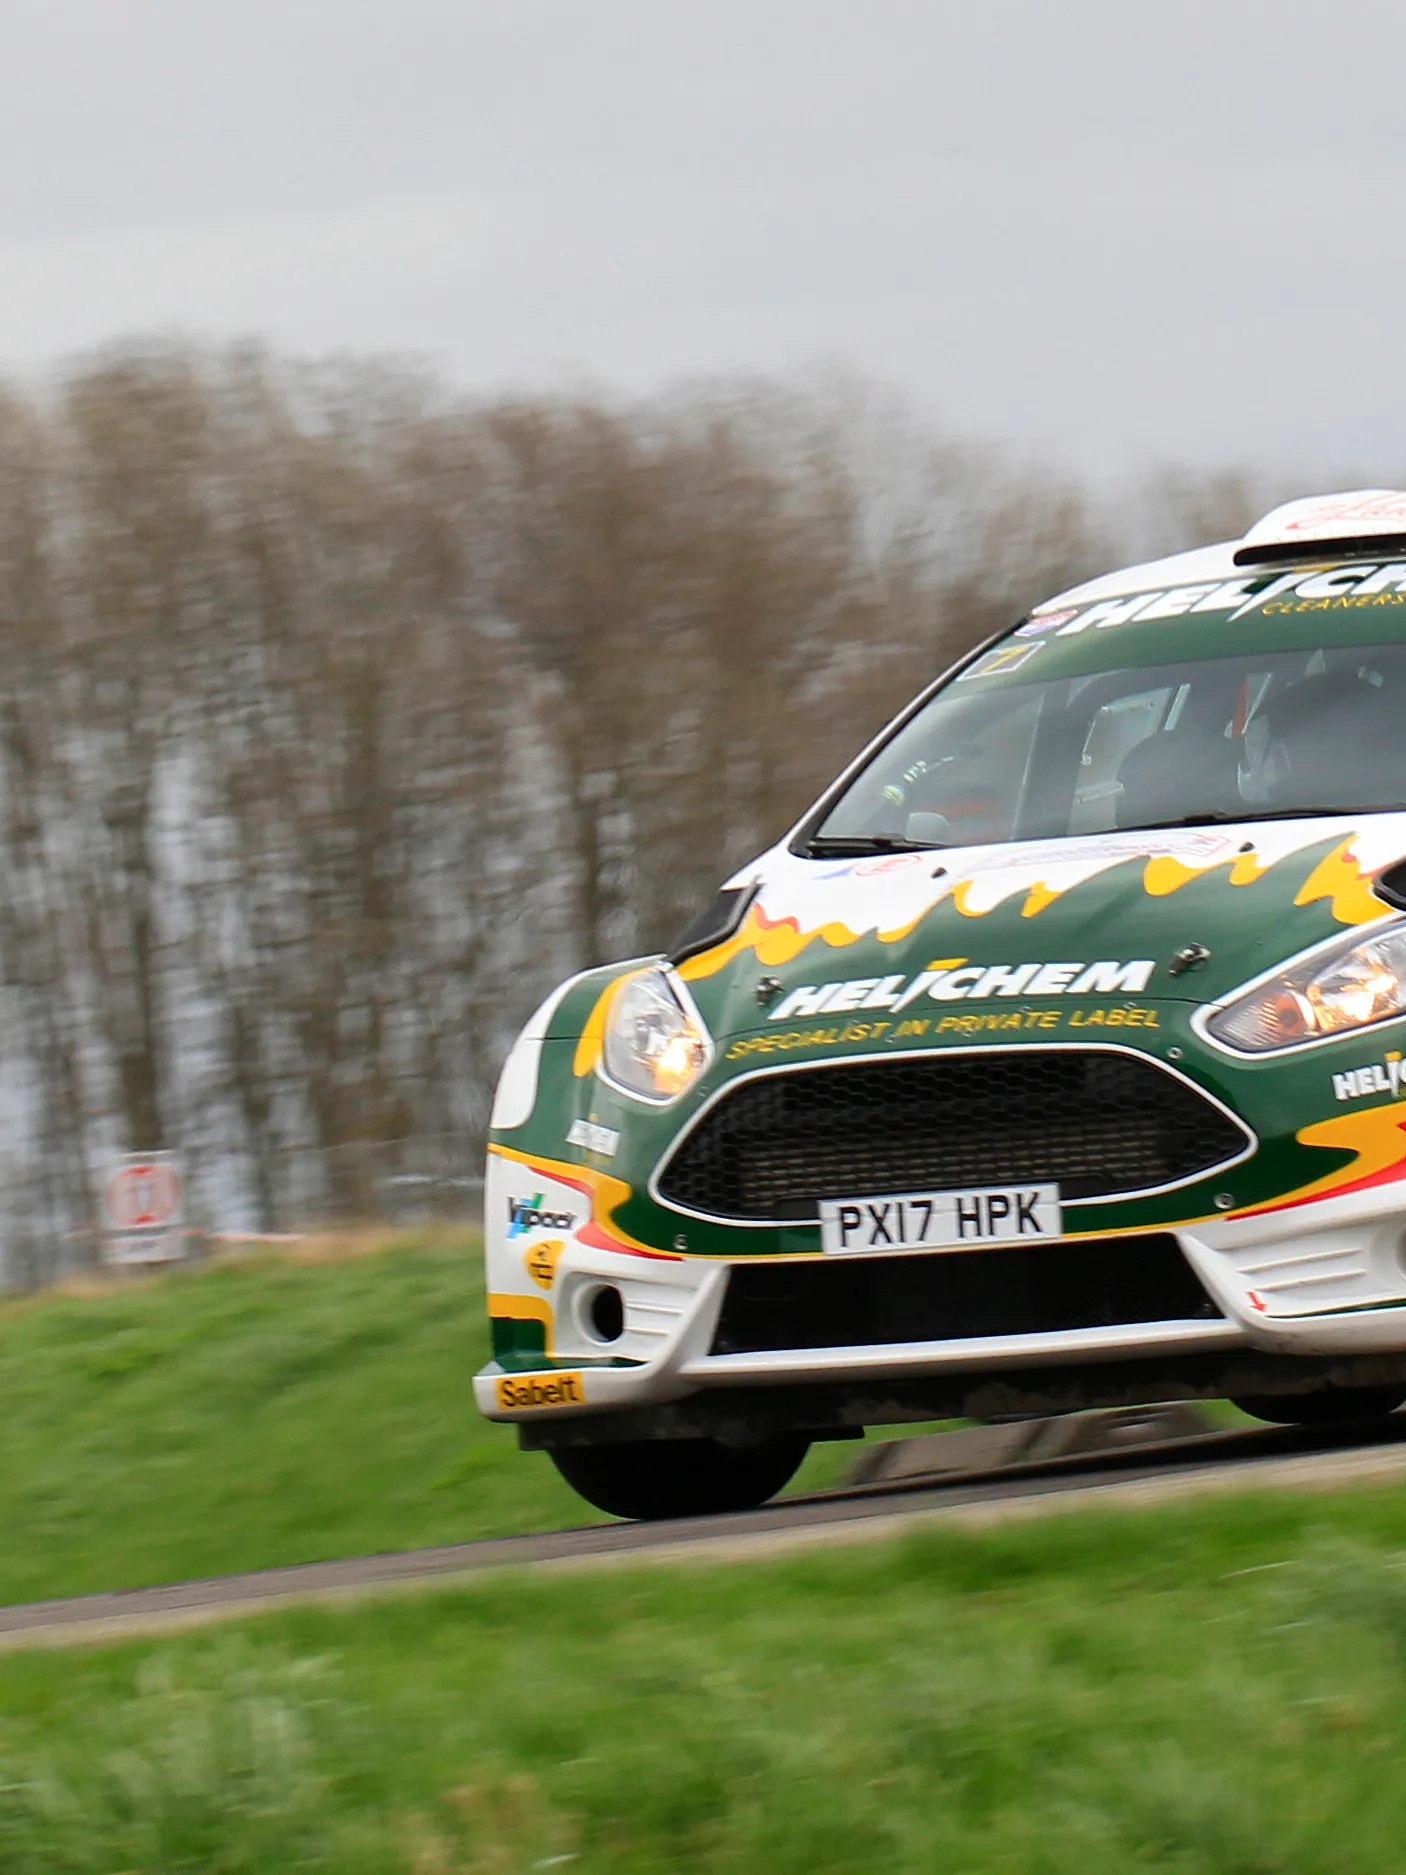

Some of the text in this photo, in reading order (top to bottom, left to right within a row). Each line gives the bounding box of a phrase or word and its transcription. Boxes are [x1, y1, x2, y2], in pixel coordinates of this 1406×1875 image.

[725, 1008, 1161, 1060] SPECIALIST IN PRIVATE LABEL
[838, 1191, 1043, 1248] PX17 HPK
[501, 1376, 579, 1408] Sabelt
